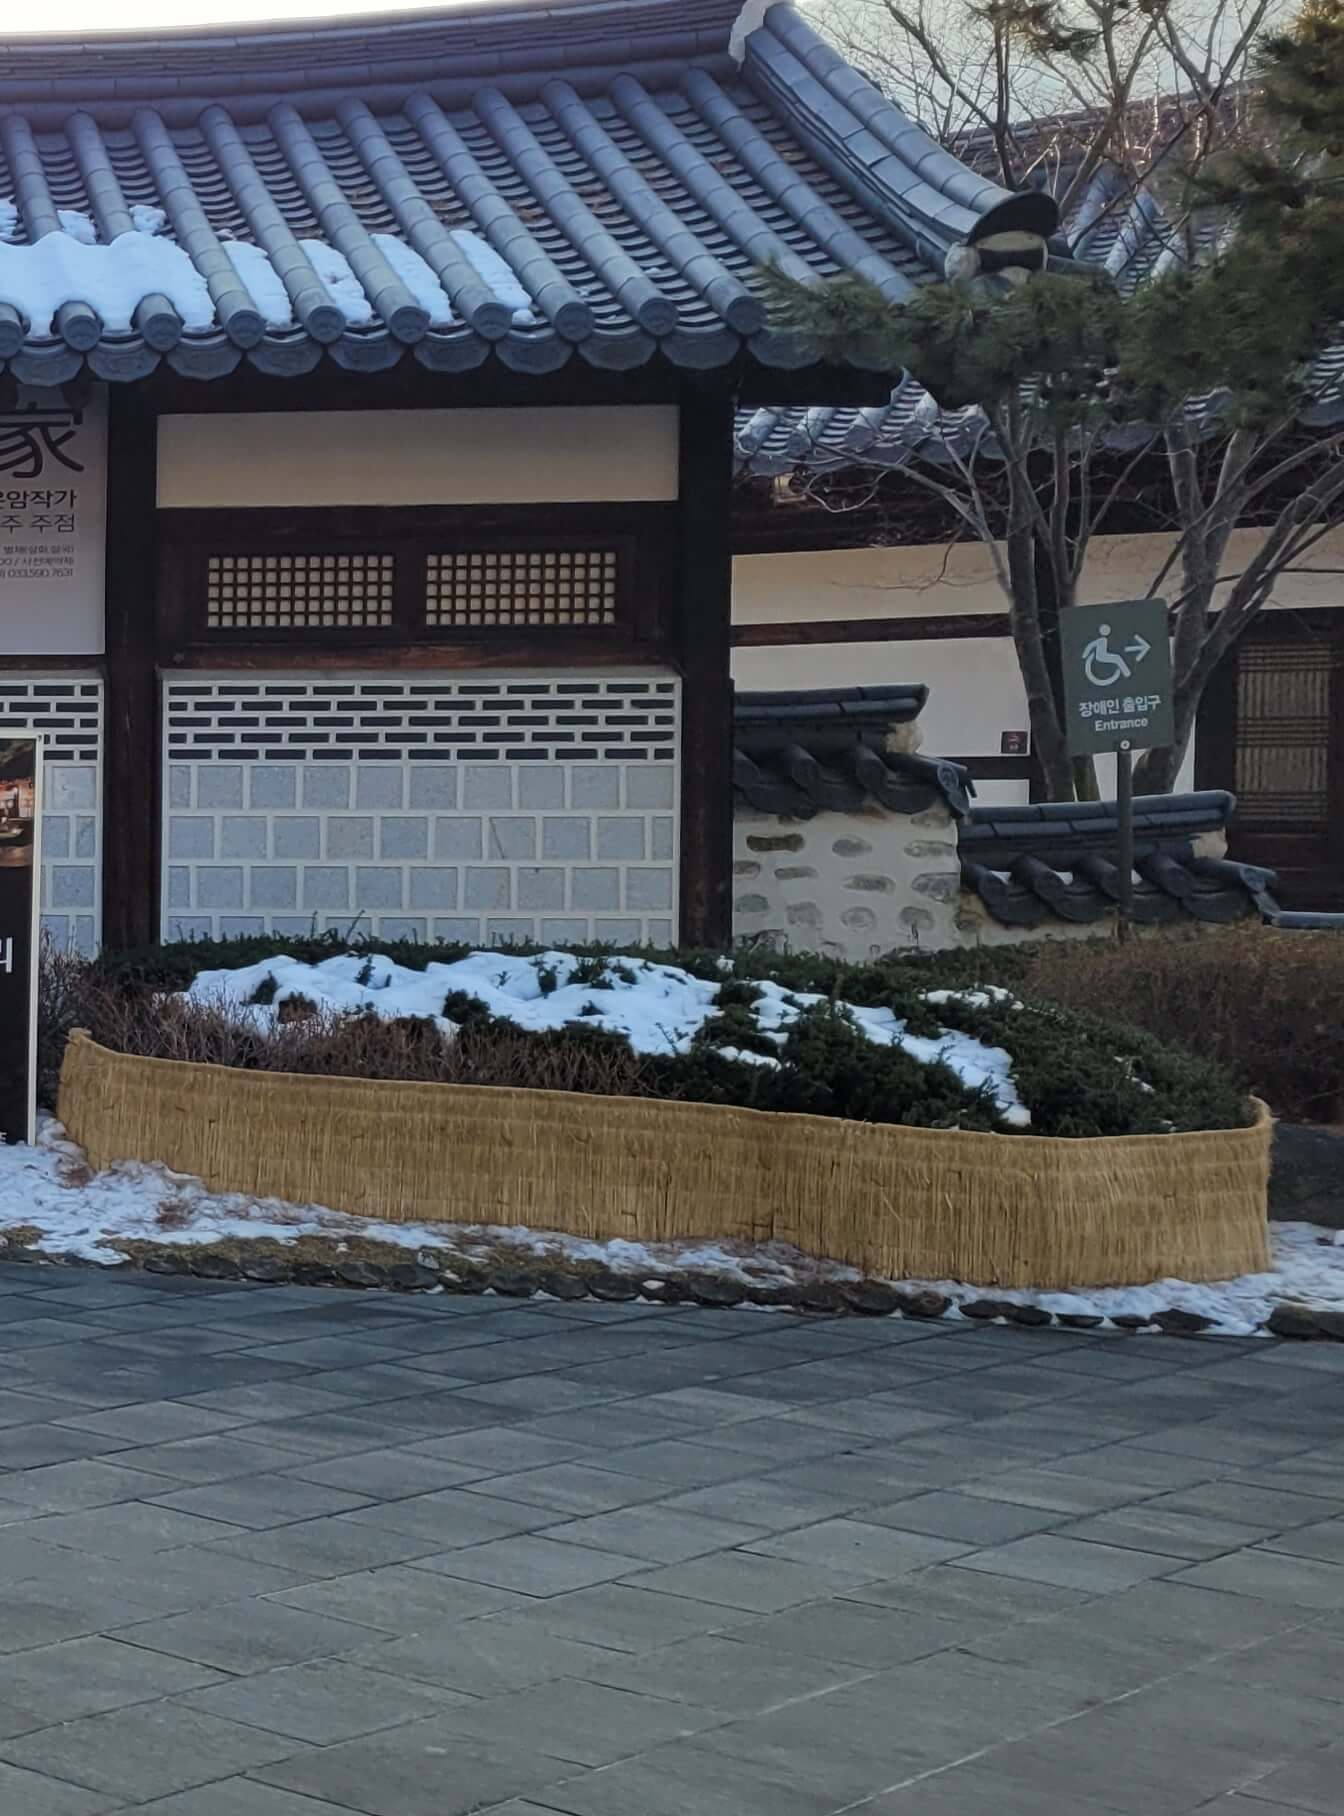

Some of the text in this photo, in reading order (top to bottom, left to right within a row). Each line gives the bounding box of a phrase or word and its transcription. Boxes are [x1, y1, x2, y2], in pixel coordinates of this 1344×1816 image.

[30, 513, 76, 534] 주점
[1079, 695, 1162, 718] 장애인 출입구
[1094, 717, 1149, 732] Entrance
